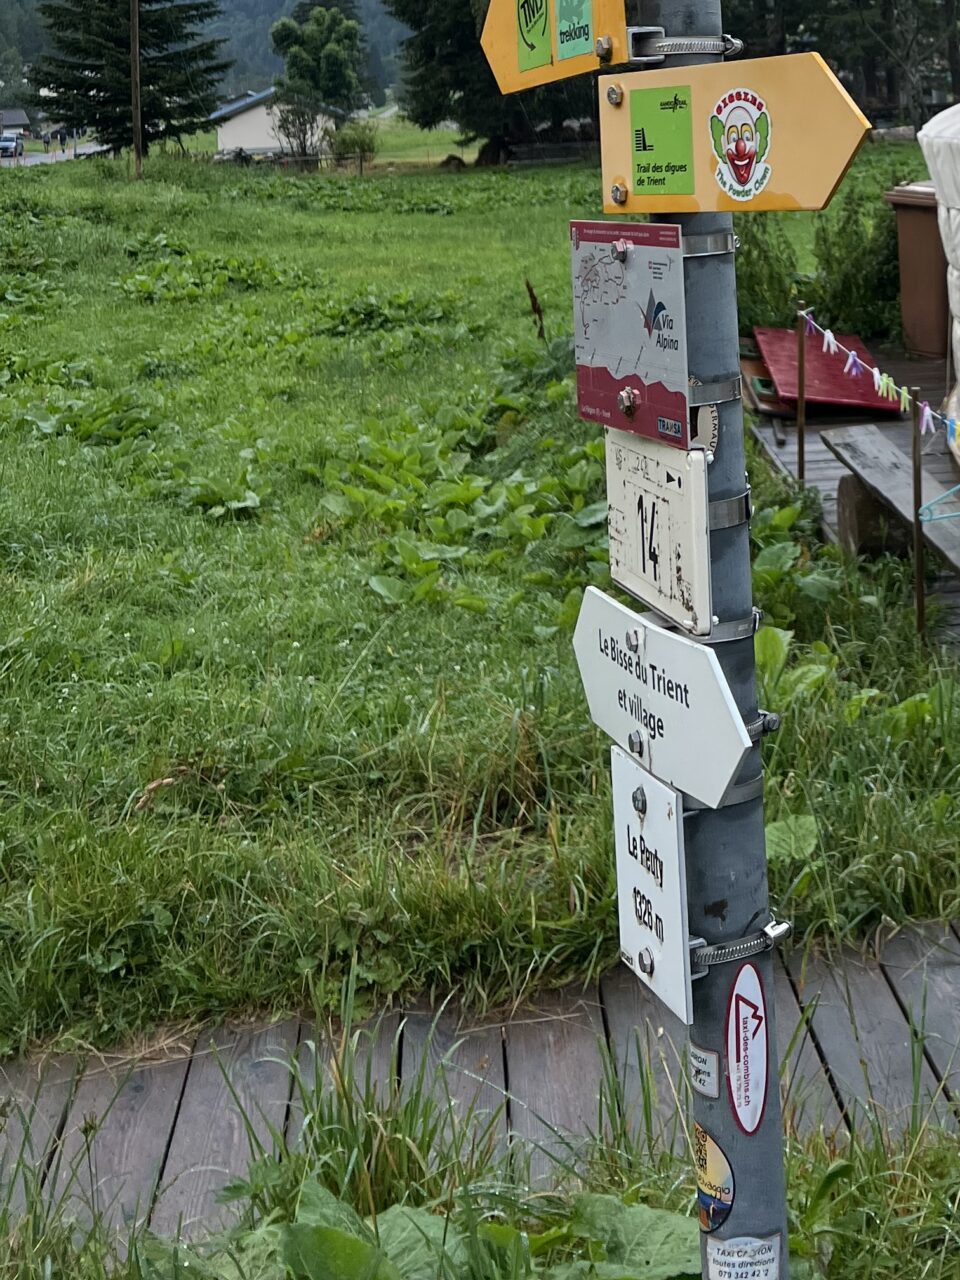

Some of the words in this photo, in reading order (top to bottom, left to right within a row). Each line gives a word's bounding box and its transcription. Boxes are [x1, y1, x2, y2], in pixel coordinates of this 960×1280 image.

[559, 21, 590, 45] trekking
[715, 91, 765, 115] GIGGLES
[636, 162, 651, 174] Trail
[652, 162, 663, 173] des
[664, 162, 688, 175] digues
[636, 176, 645, 186] de
[646, 176, 666, 186] Trient
[716, 167, 727, 188] The
[728, 183, 753, 198] Powder
[754, 165, 770, 191] Clown
[661, 313, 674, 330] Via
[656, 333, 679, 353] Alpina
[637, 494, 659, 582] 14
[598, 628, 609, 657] Le
[610, 637, 633, 675] Bisse
[635, 654, 648, 686] du
[649, 663, 690, 709] Trient
[617, 689, 628, 713] et
[628, 693, 664, 740] village
[626, 824, 638, 861] Le
[639, 834, 664, 889] Peuty
[633, 886, 653, 931] 1326
[655, 912, 665, 943] m
[742, 1016, 751, 1107] taxi-des-combins.ch
[712, 1258, 736, 1269] toutes
[738, 1257, 775, 1269] directions
[716, 1247, 734, 1258] TAXI
